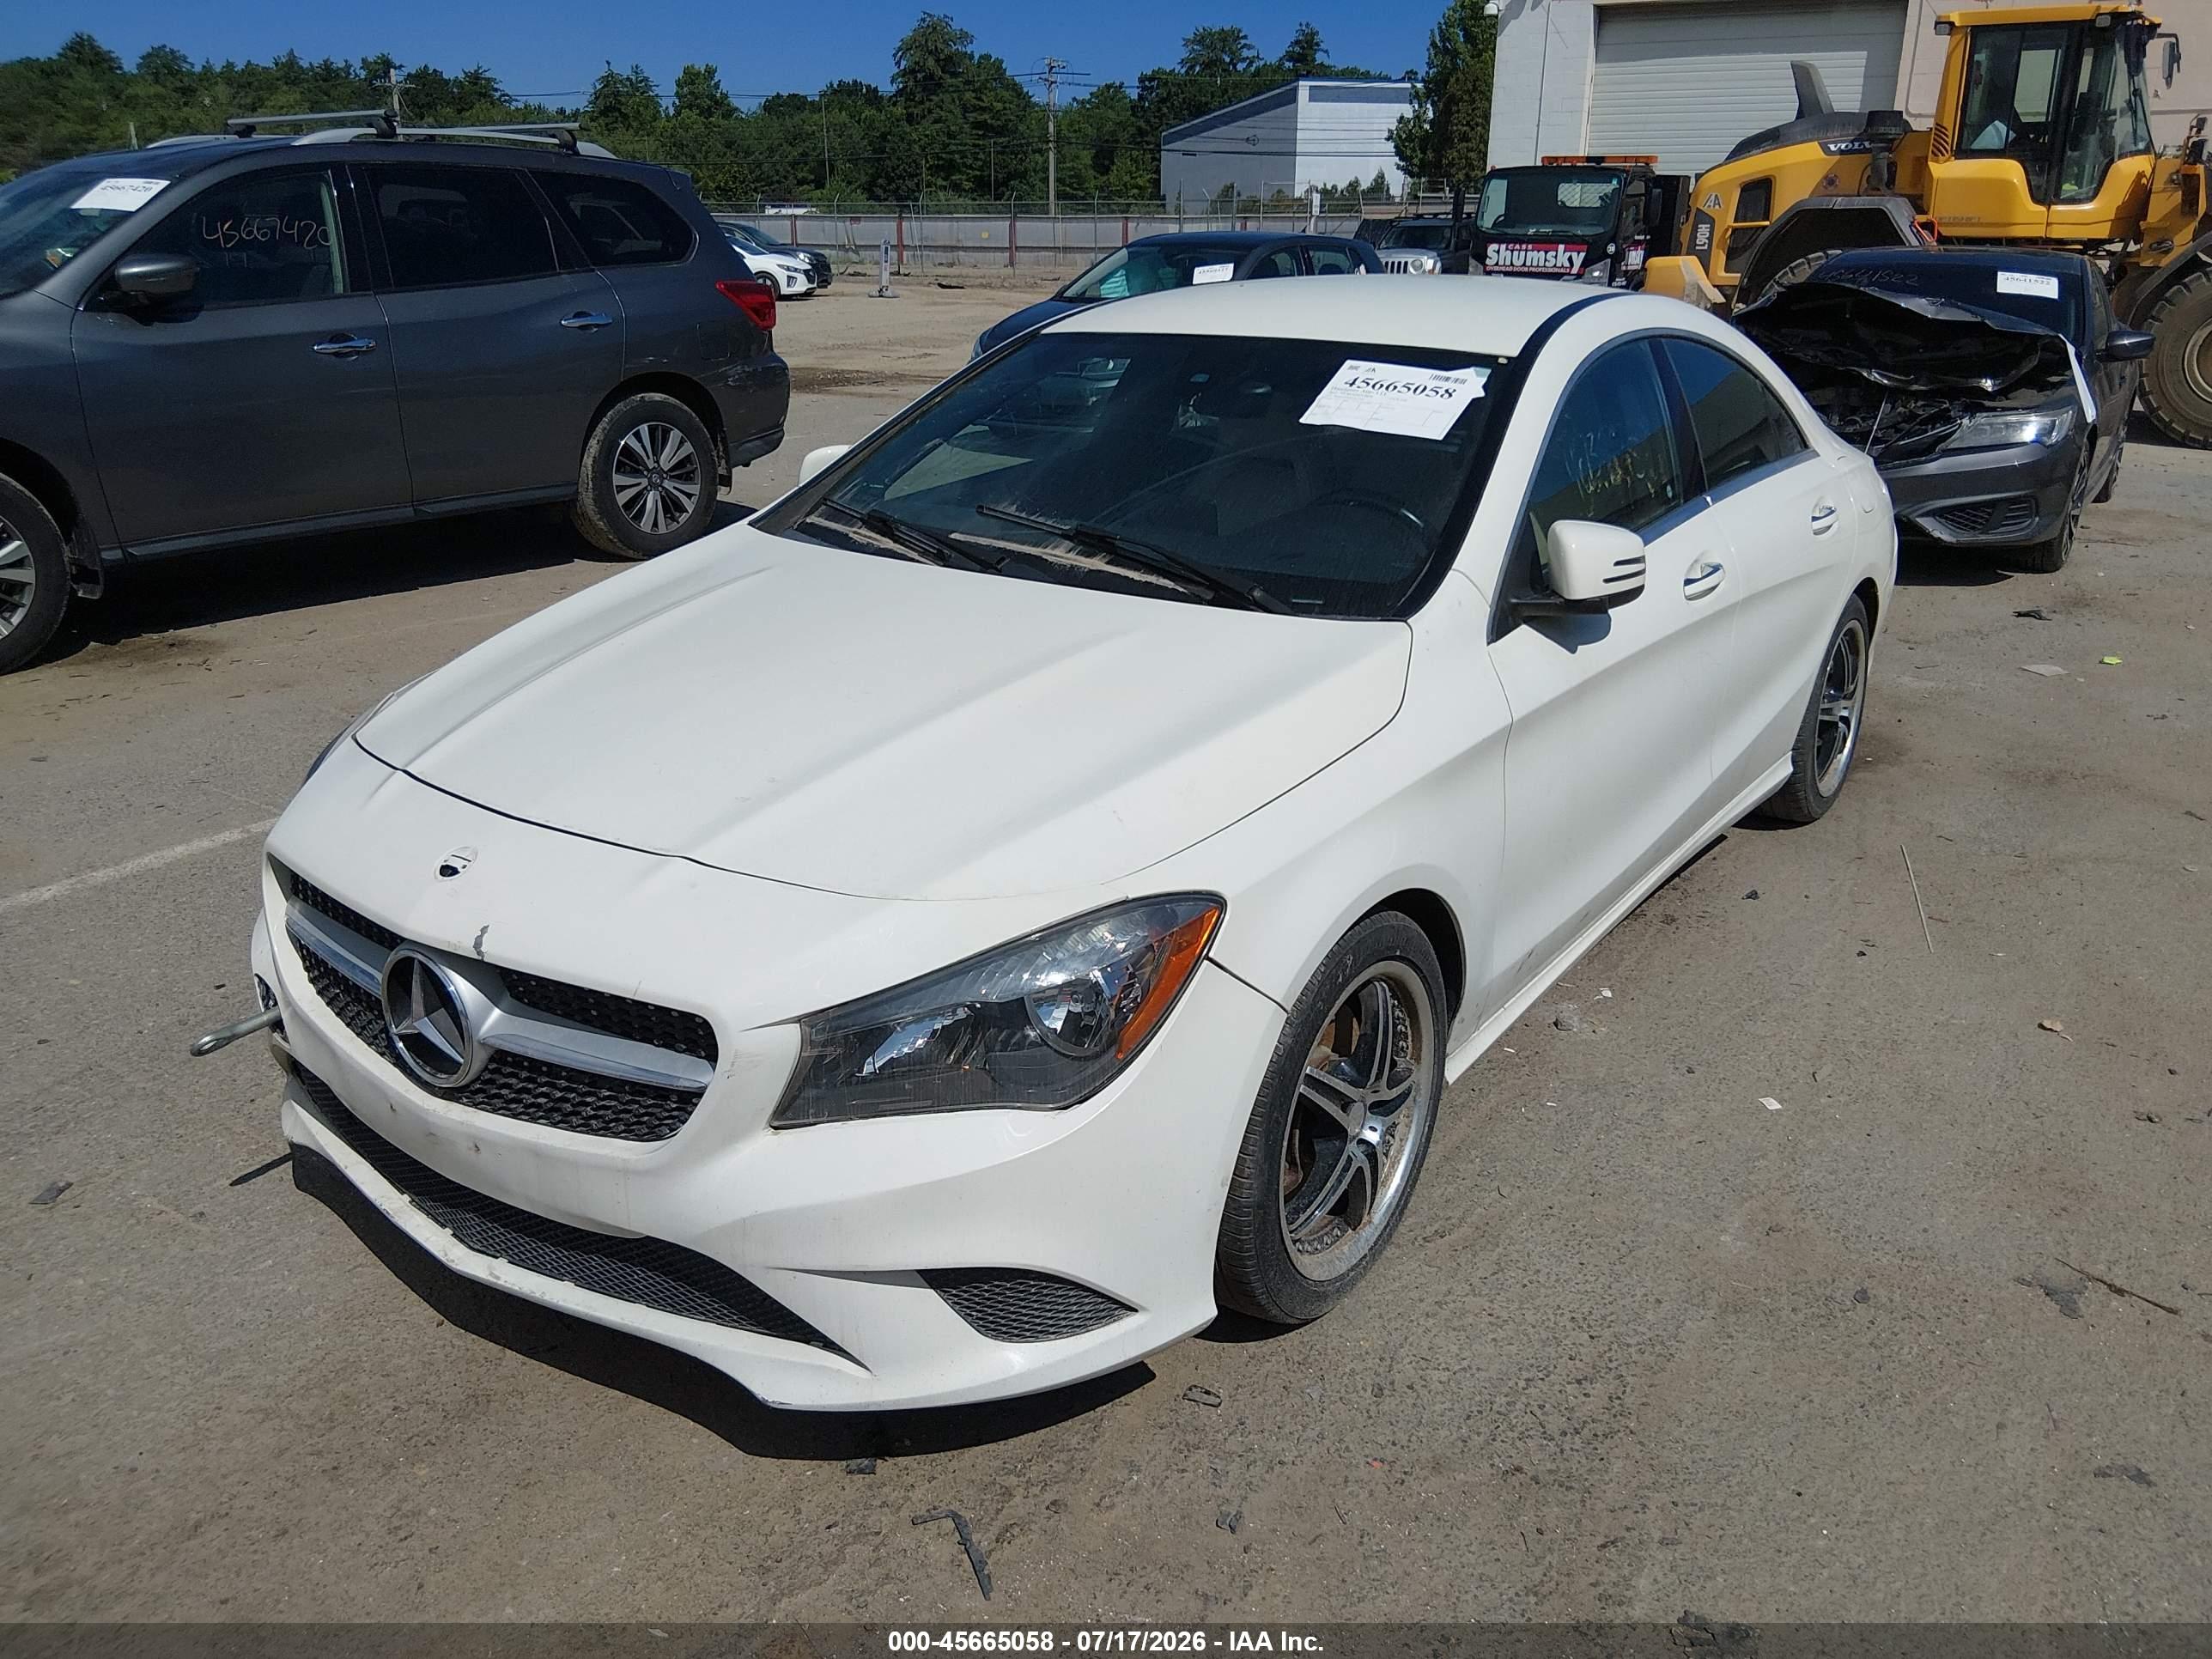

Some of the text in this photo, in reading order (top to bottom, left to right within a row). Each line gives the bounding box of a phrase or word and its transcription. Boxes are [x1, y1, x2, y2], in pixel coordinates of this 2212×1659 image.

[1827, 141, 1873, 151] VOLV
[202, 216, 331, 250] 45667420
[1695, 223, 1711, 250] L90H
[1485, 243, 1587, 274] Shumsky
[1344, 376, 1457, 399] 45665058
